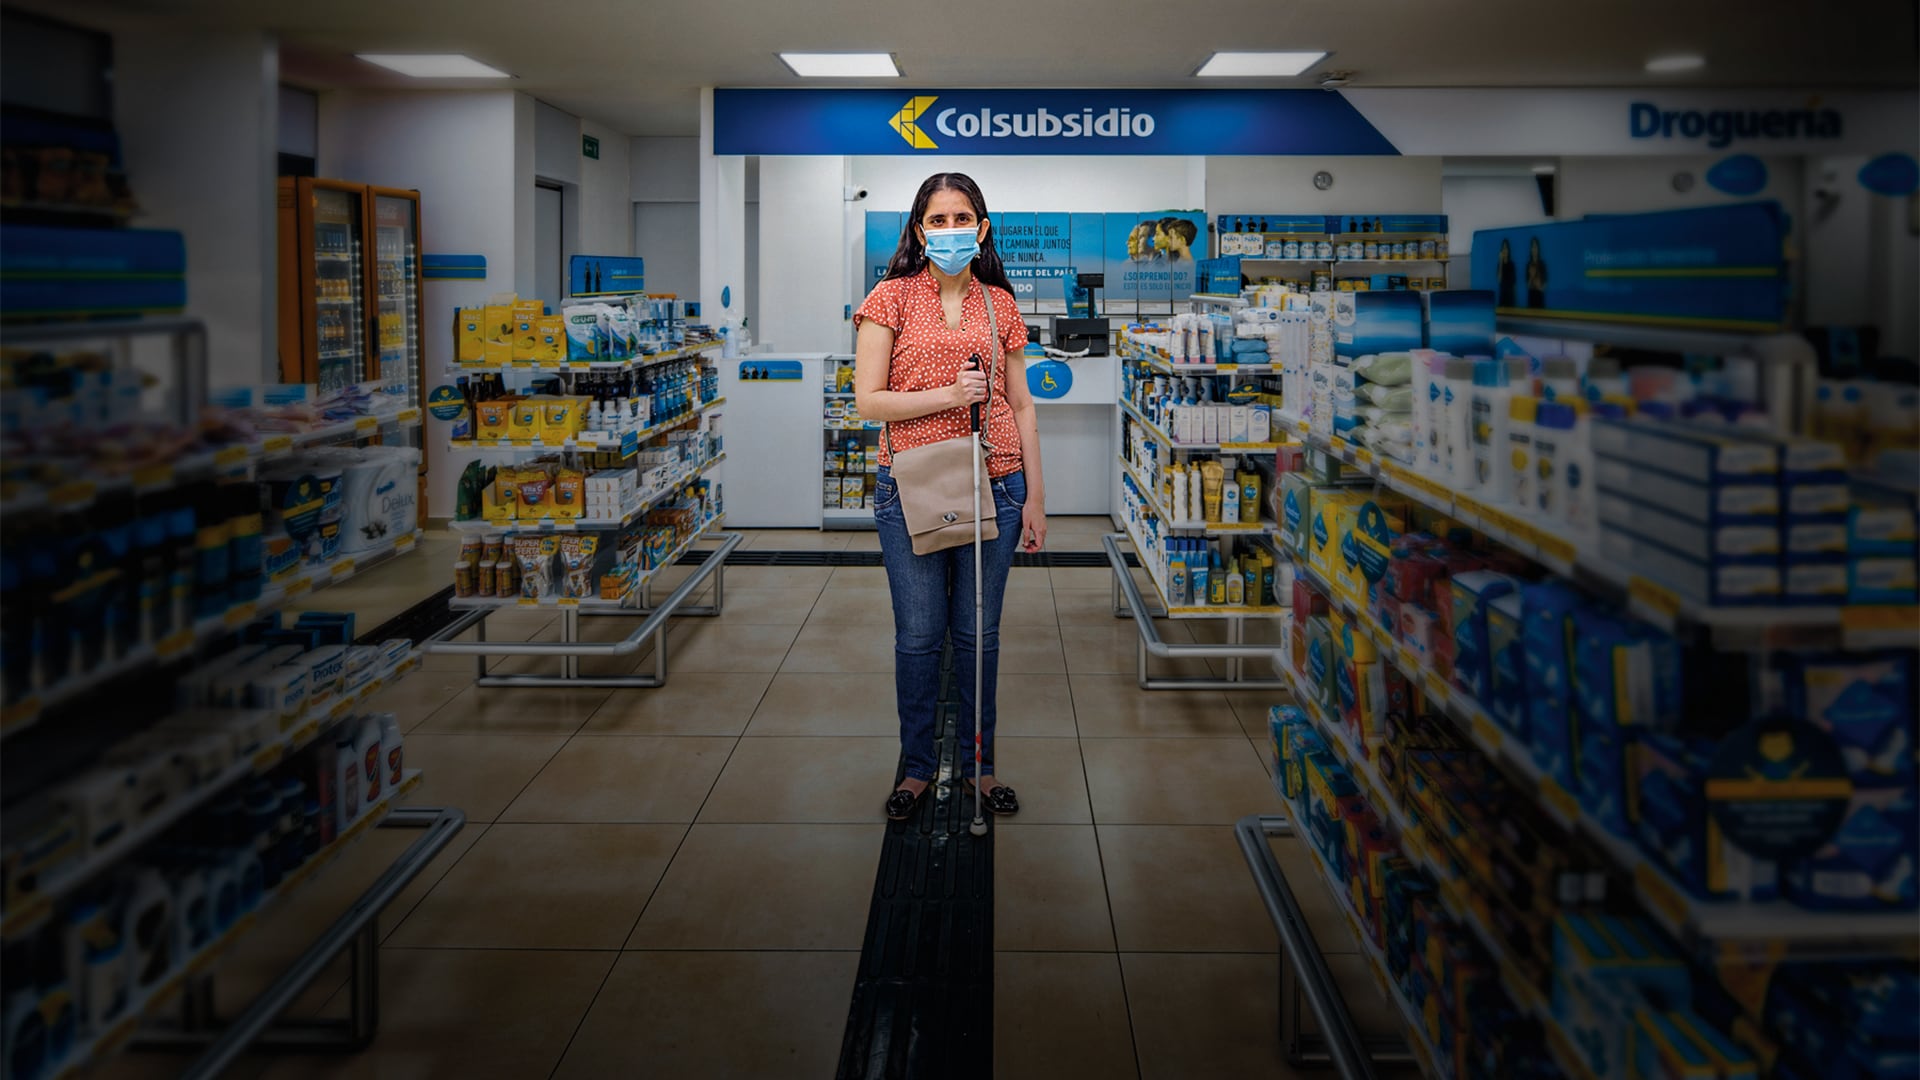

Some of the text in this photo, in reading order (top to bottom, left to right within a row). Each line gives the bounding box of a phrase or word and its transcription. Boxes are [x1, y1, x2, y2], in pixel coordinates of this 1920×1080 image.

[936, 107, 1155, 138] Colsubsidio
[1630, 93, 1842, 148] Droguería
[1000, 225, 1023, 236] LUGAR
[1024, 225, 1034, 236] EN
[1044, 226, 1059, 236] QUE
[1005, 238, 1040, 249] CAMINAR
[1042, 238, 1071, 250] JUNTOS
[1018, 252, 1047, 263] NUNCA.
[1006, 269, 1033, 277] YENTE
[1035, 269, 1052, 277] DEL
